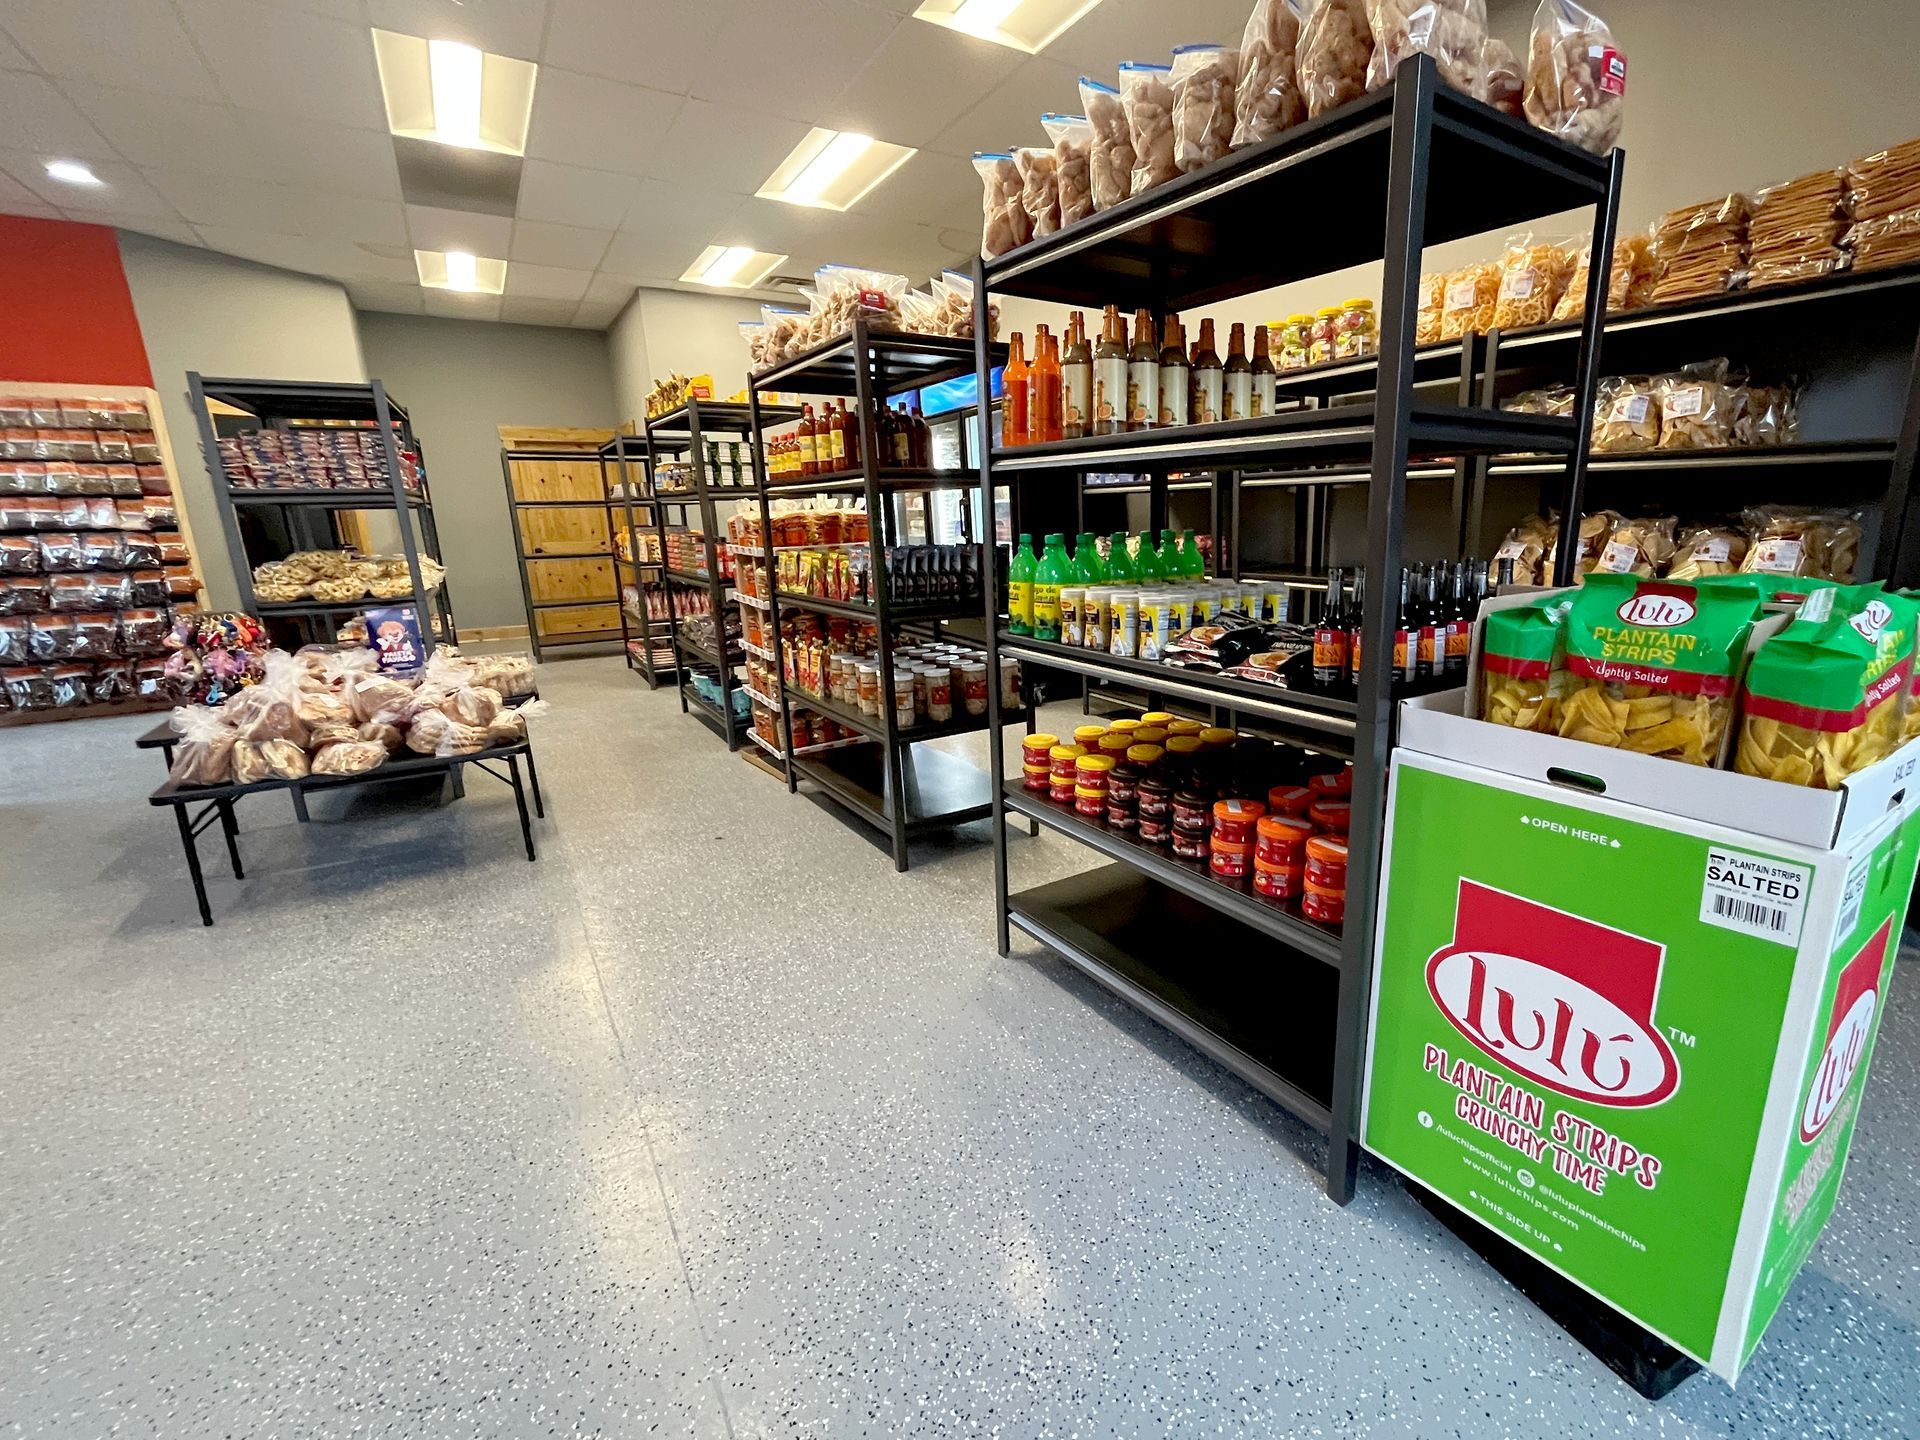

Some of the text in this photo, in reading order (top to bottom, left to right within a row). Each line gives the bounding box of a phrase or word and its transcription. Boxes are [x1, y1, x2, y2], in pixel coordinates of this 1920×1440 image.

[1593, 626, 1697, 650] PLANTAIN
[1602, 643, 1677, 665] STRIPS
[1596, 664, 1669, 684] Lightly Salted
[1532, 817, 1608, 846] OPEN HERE
[1707, 866, 1800, 900] SALTED
[1729, 858, 1769, 875] PLANTAIN
[1771, 868, 1801, 882] STRIPS
[1667, 1026, 1696, 1048] TM
[1425, 1043, 1661, 1189] PLANTAIN STRIPS
[1456, 1096, 1608, 1195] CRUNCHY TIME
[1463, 1155, 1579, 1231] www.luluchips.com
[1479, 1194, 1551, 1244] THIS SIDE UP
